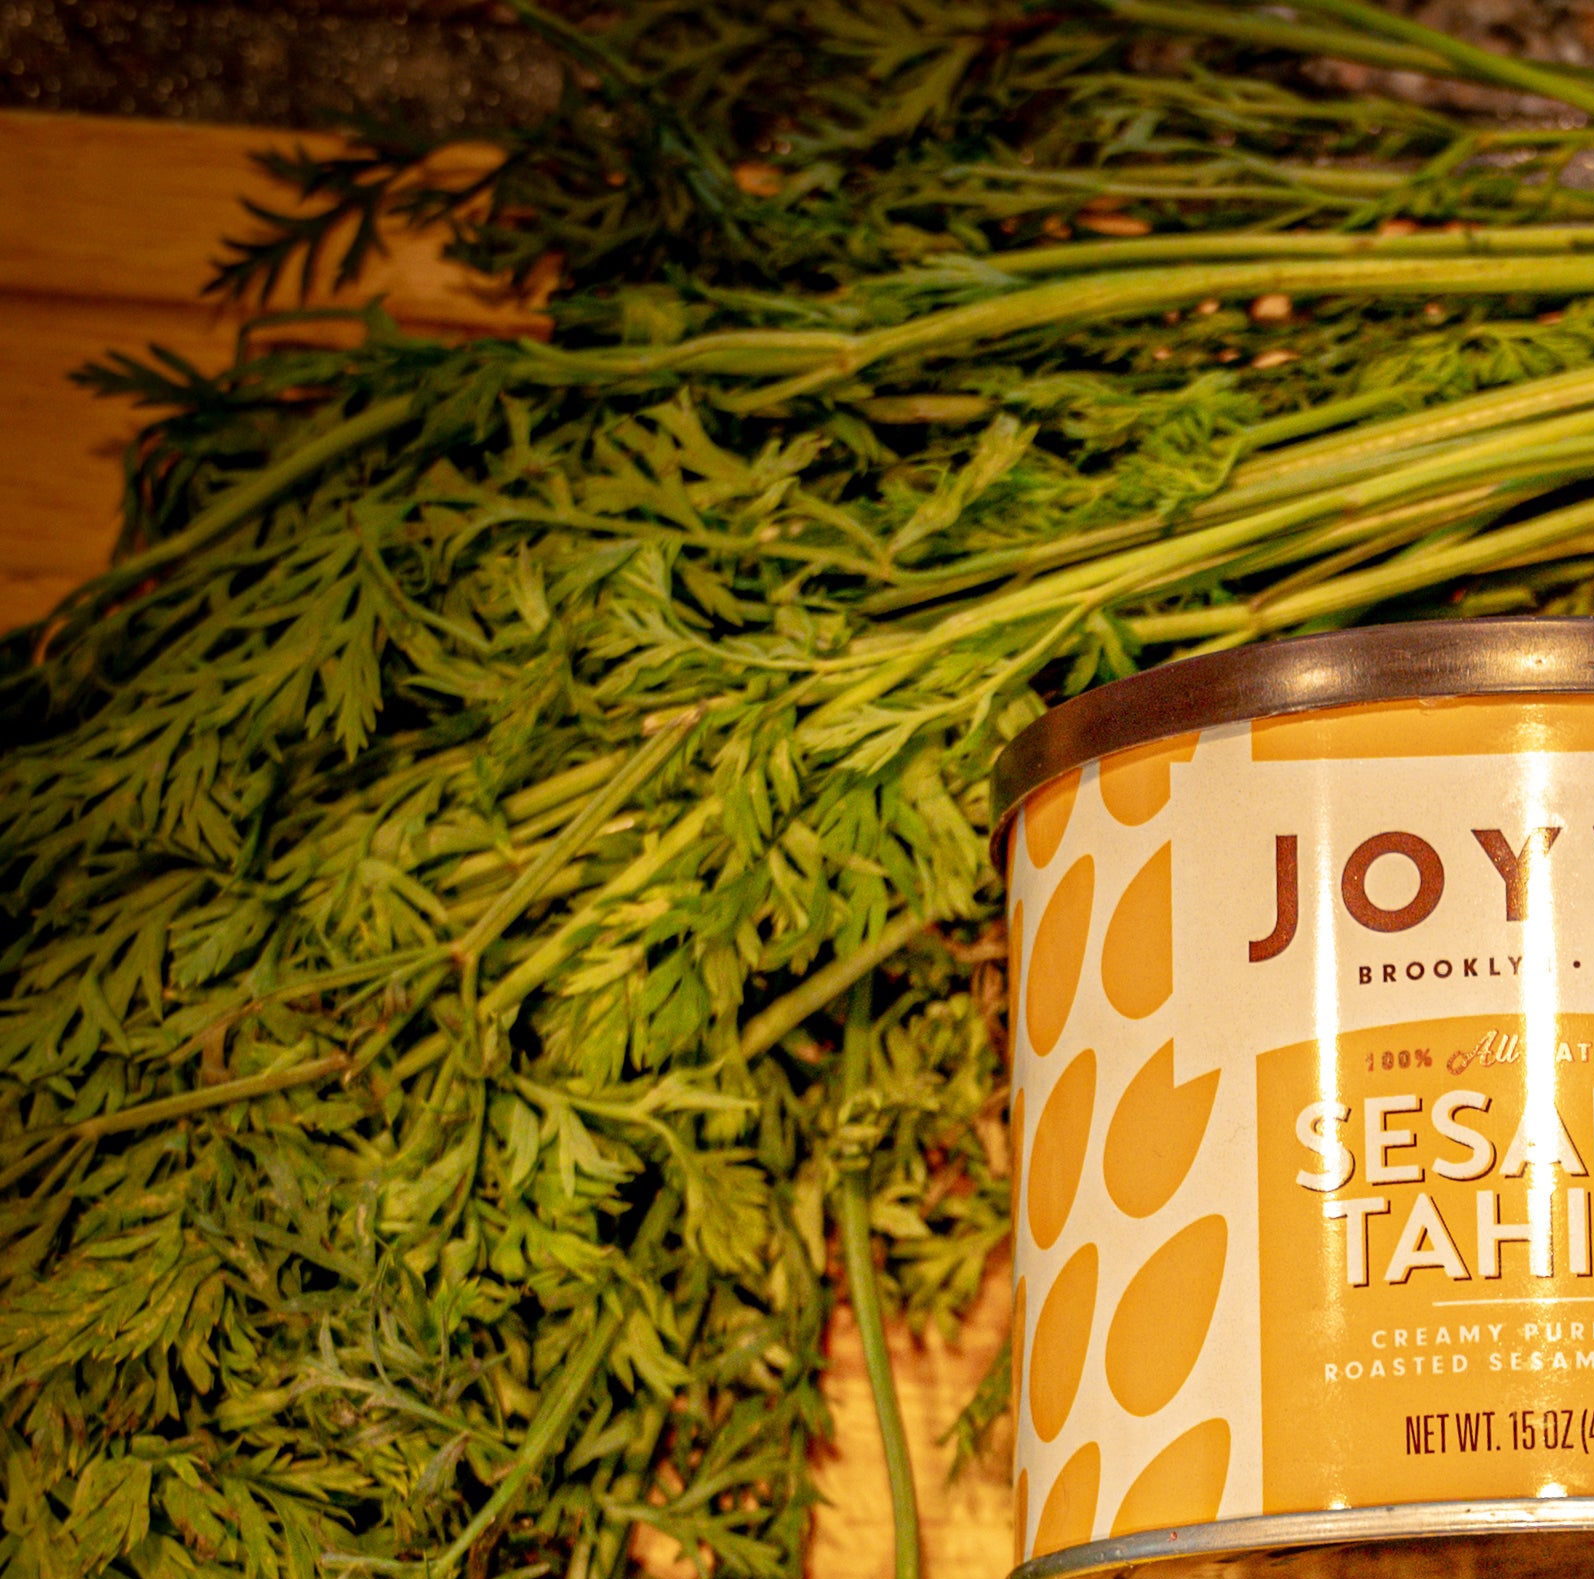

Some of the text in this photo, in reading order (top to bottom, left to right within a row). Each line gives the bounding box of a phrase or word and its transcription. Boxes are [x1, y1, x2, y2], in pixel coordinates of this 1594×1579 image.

[1358, 955, 1552, 985] BROOKLY
[1365, 1048, 1433, 1072] 100%
[1371, 1324, 1504, 1349] CREAMY
[1323, 1355, 1469, 1383] ROASTED
[1405, 1413, 1450, 1455] NET
[1456, 1412, 1501, 1453] WT.
[1508, 1410, 1536, 1450] 15
[1543, 1410, 1575, 1450] OZ
